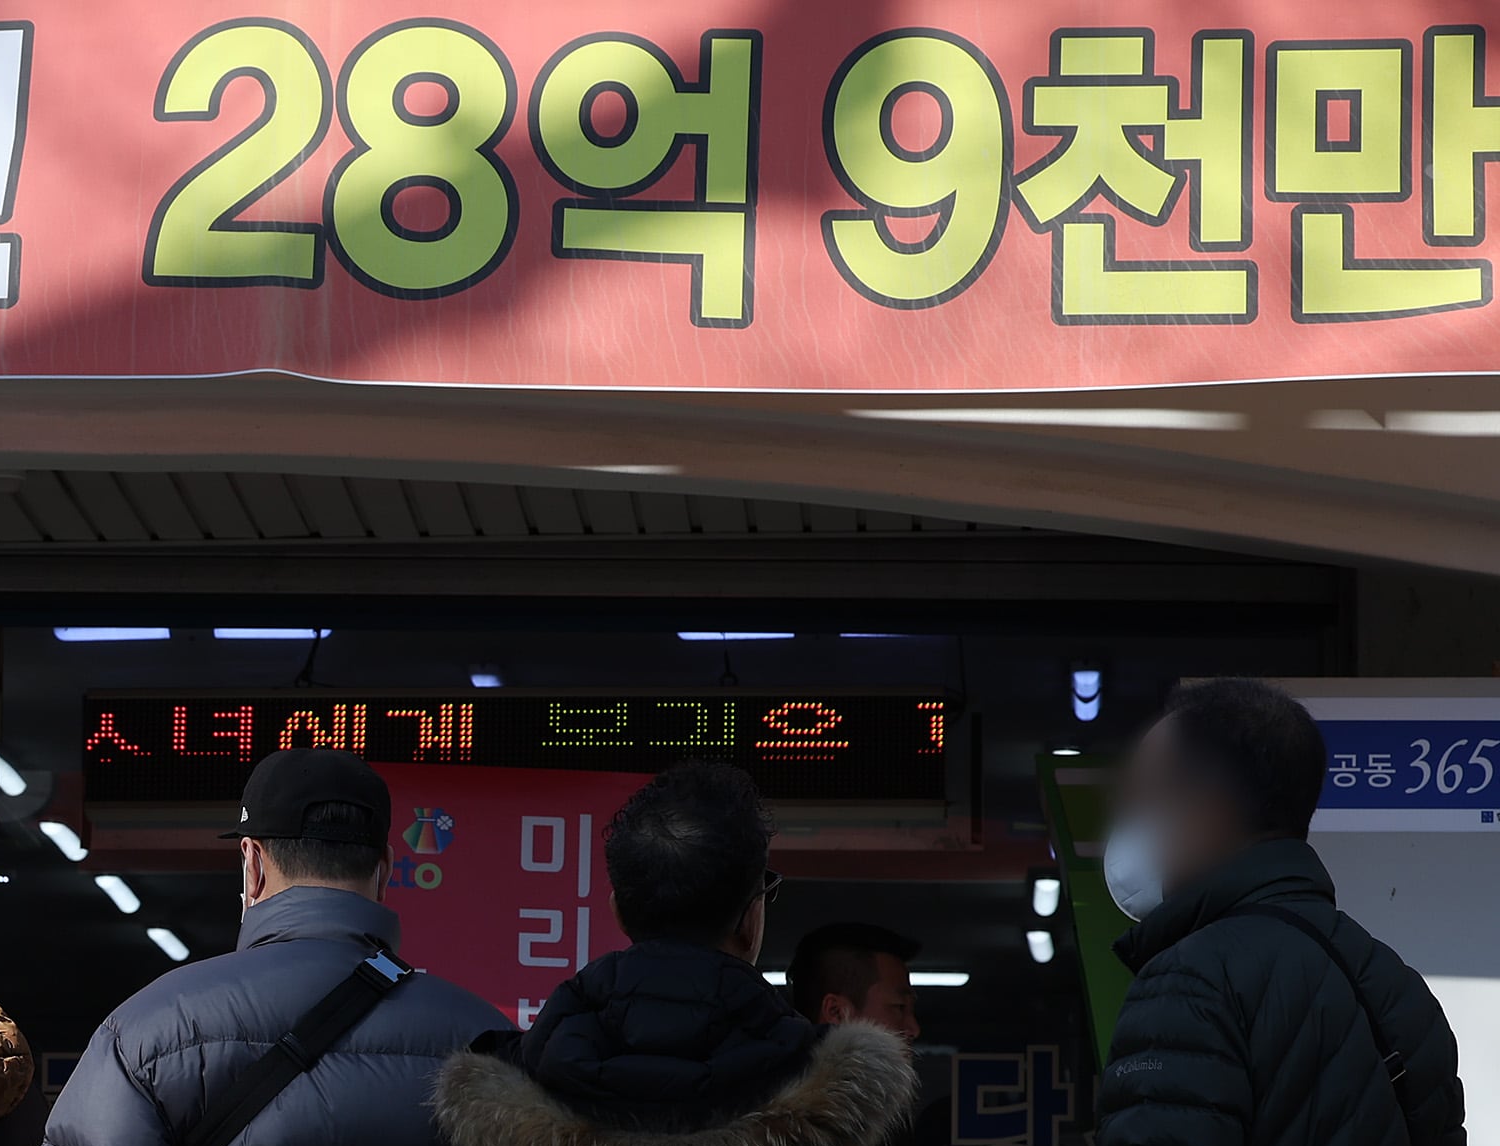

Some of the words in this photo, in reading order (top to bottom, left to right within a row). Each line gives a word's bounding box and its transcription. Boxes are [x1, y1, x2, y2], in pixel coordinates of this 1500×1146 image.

[142, 17, 762, 328] 28억
[821, 25, 1500, 324] 9천만
[1329, 754, 1396, 787] 공동
[1405, 738, 1500, 793] 365
